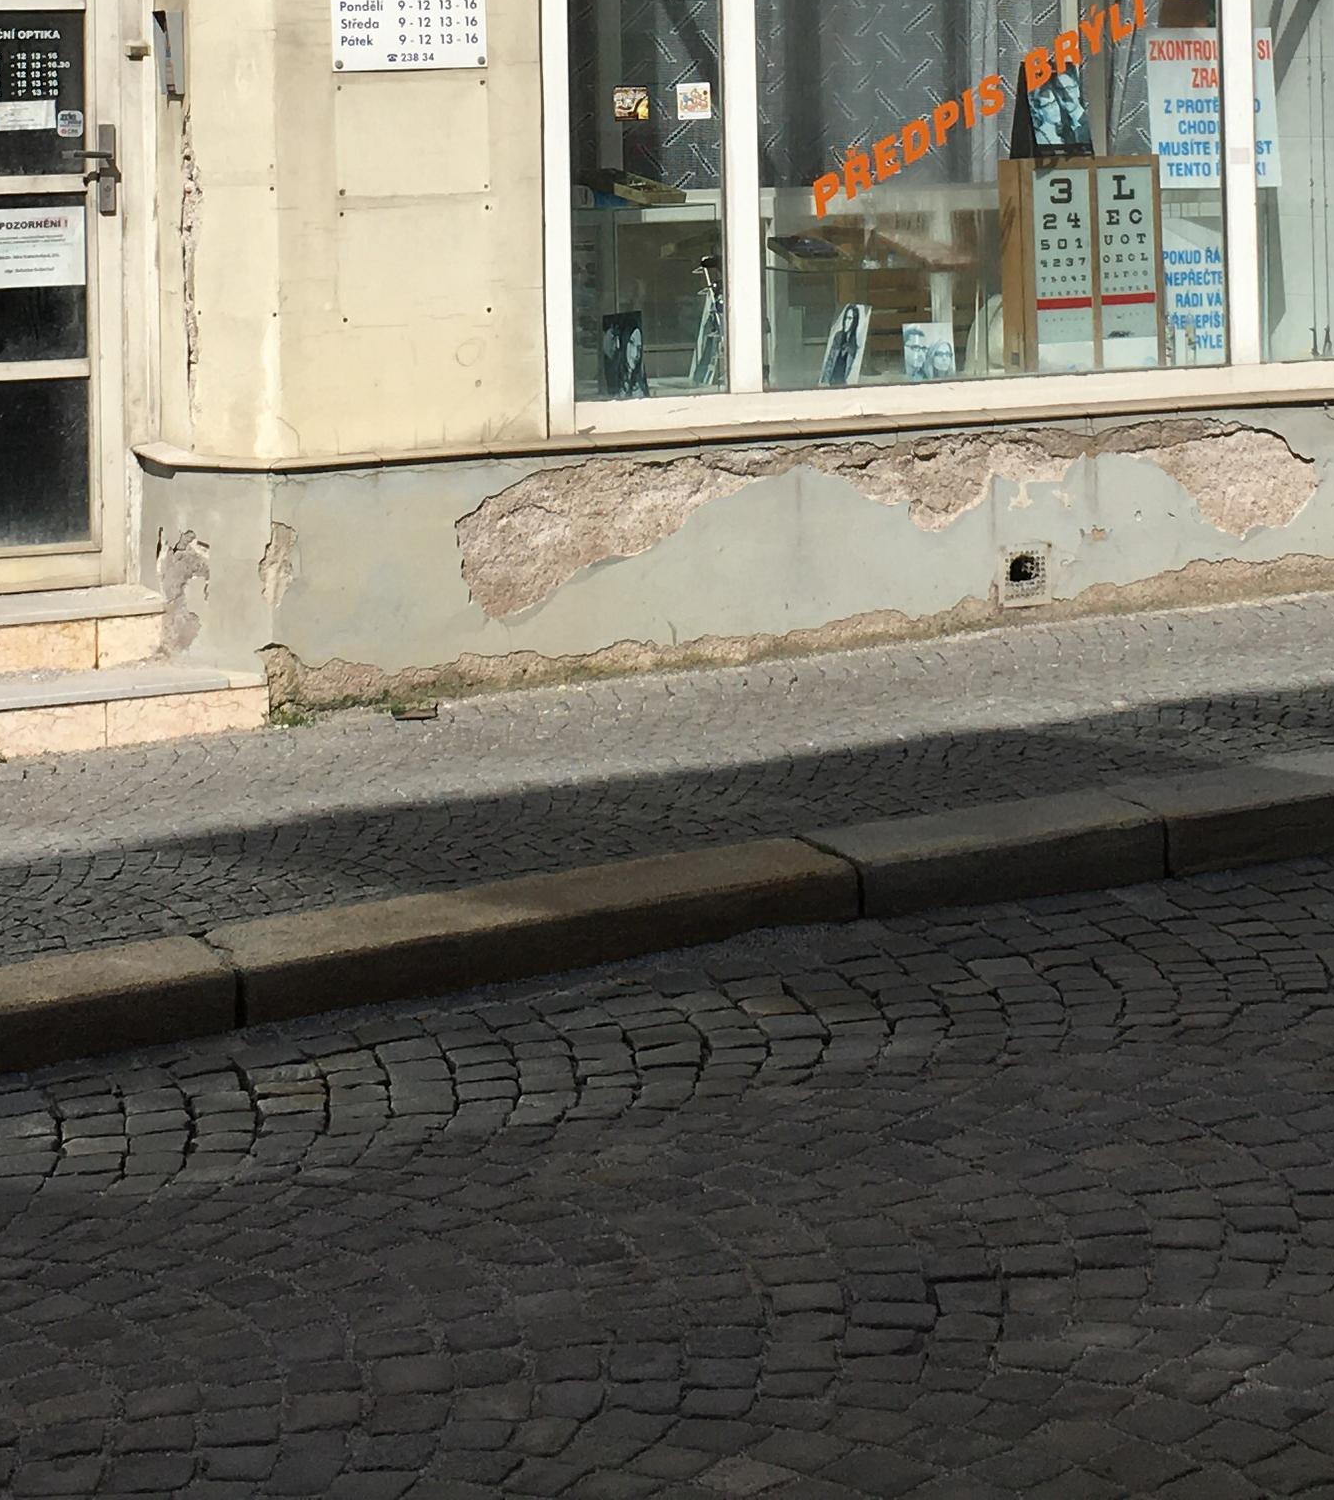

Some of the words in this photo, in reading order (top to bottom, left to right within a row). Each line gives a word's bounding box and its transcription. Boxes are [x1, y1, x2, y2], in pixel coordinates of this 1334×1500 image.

[339, 0, 384, 12] Pondělí
[397, 0, 405, 11] 9
[417, 0, 431, 11] 12
[439, 0, 453, 10] 13
[340, 17, 380, 30] Středa
[398, 17, 406, 28] 9
[418, 17, 431, 28] 12
[439, 16, 453, 28] 13
[465, 16, 478, 27] 16
[17, 30, 61, 40] OPTIKA
[341, 34, 374, 46] Pátek
[399, 34, 407, 45] 9
[419, 34, 432, 45] 12
[440, 33, 453, 44] 13
[465, 32, 479, 44] 16
[16, 52, 27, 60] 12
[31, 52, 41, 60] 13
[401, 53, 419, 62] 238
[421, 52, 435, 62] 34
[1257, 40, 1271, 61] SI
[16, 62, 27, 70] 12
[30, 70, 41, 78] 13
[1191, 67, 1219, 88] ZRA
[1163, 99, 1173, 114] Z
[1178, 120, 1219, 134] CHOD
[813, 73, 1006, 221] PŘEDPIS
[1158, 139, 1211, 156] MUSÍTE
[1167, 162, 1211, 176] TENTO
[1049, 178, 1073, 204] 3
[1112, 174, 1135, 200] L
[1163, 250, 1201, 265] POKUD
[1205, 246, 1221, 264] ŘÁ
[1165, 268, 1223, 286] NEPŘEČTE
[1175, 290, 1203, 308] RÁDI
[1207, 289, 1223, 306] VÁ
